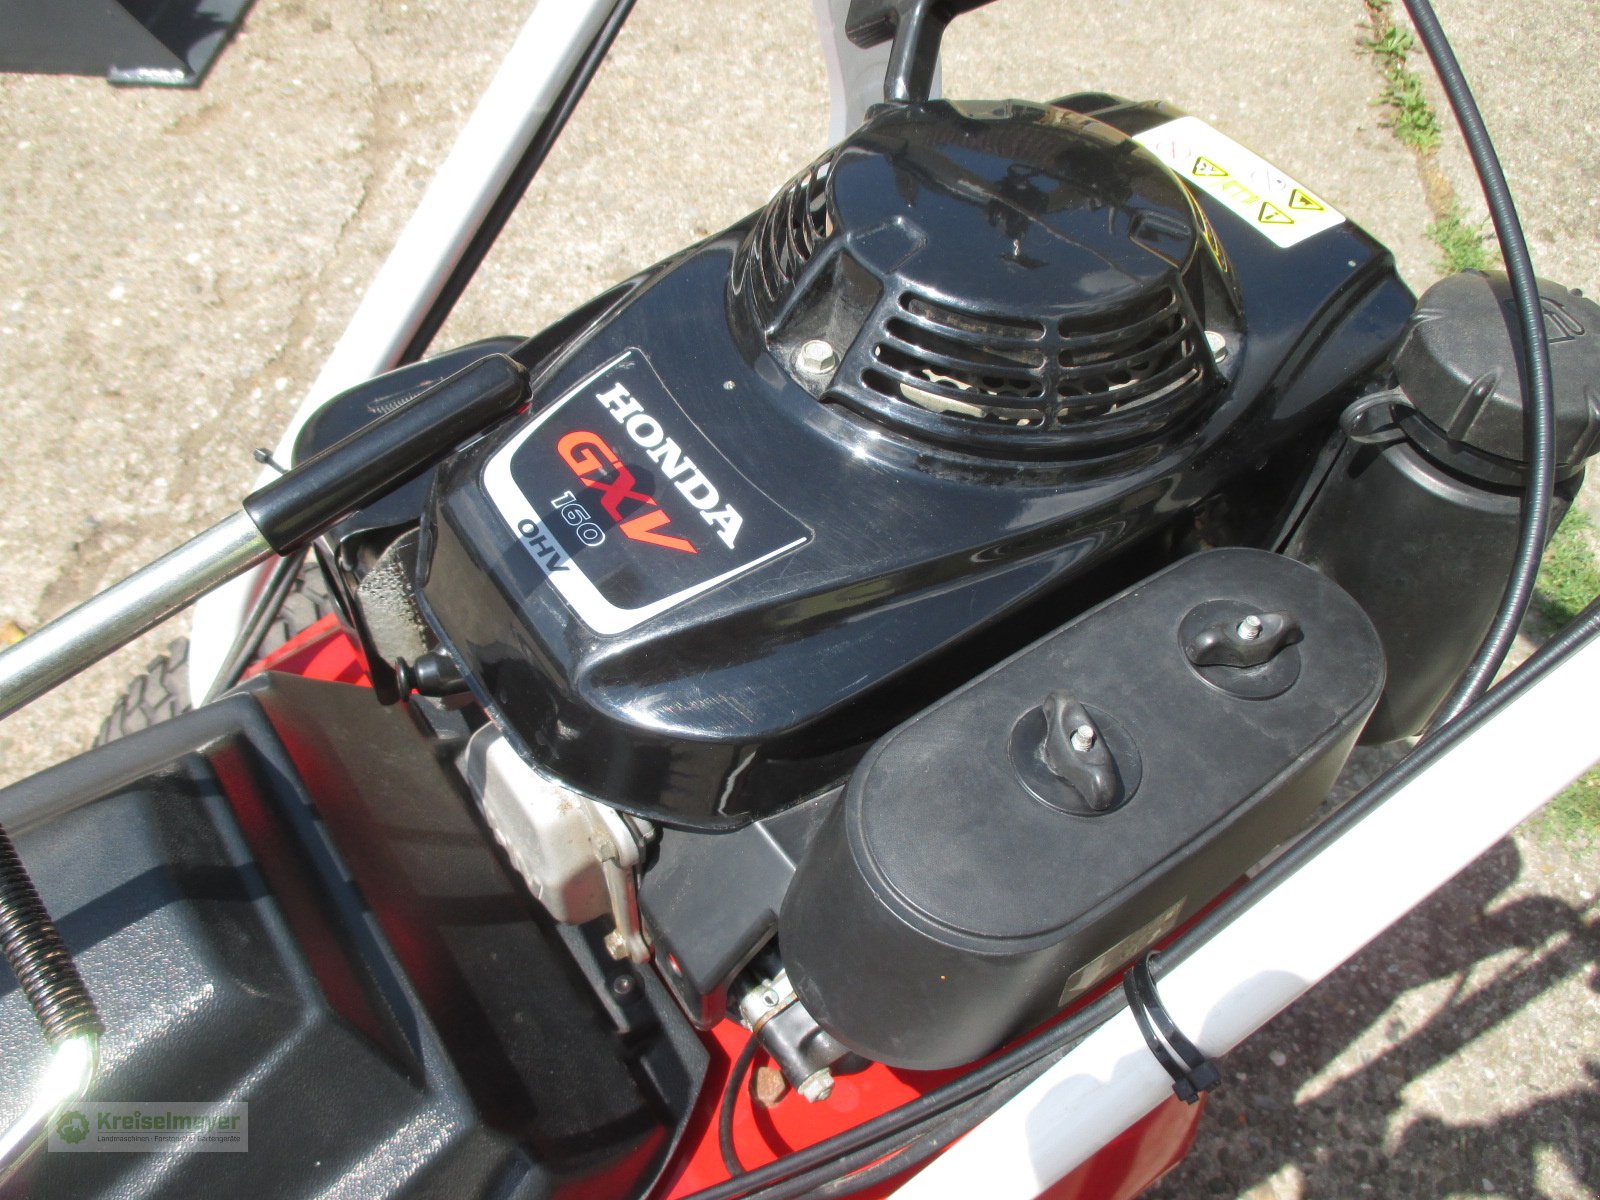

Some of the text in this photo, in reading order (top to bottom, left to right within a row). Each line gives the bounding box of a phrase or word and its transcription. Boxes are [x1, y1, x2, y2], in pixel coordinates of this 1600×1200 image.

[556, 430, 698, 554] GXV
[595, 382, 743, 549] HONDA
[517, 518, 570, 573] OHV
[550, 490, 605, 546] 160
